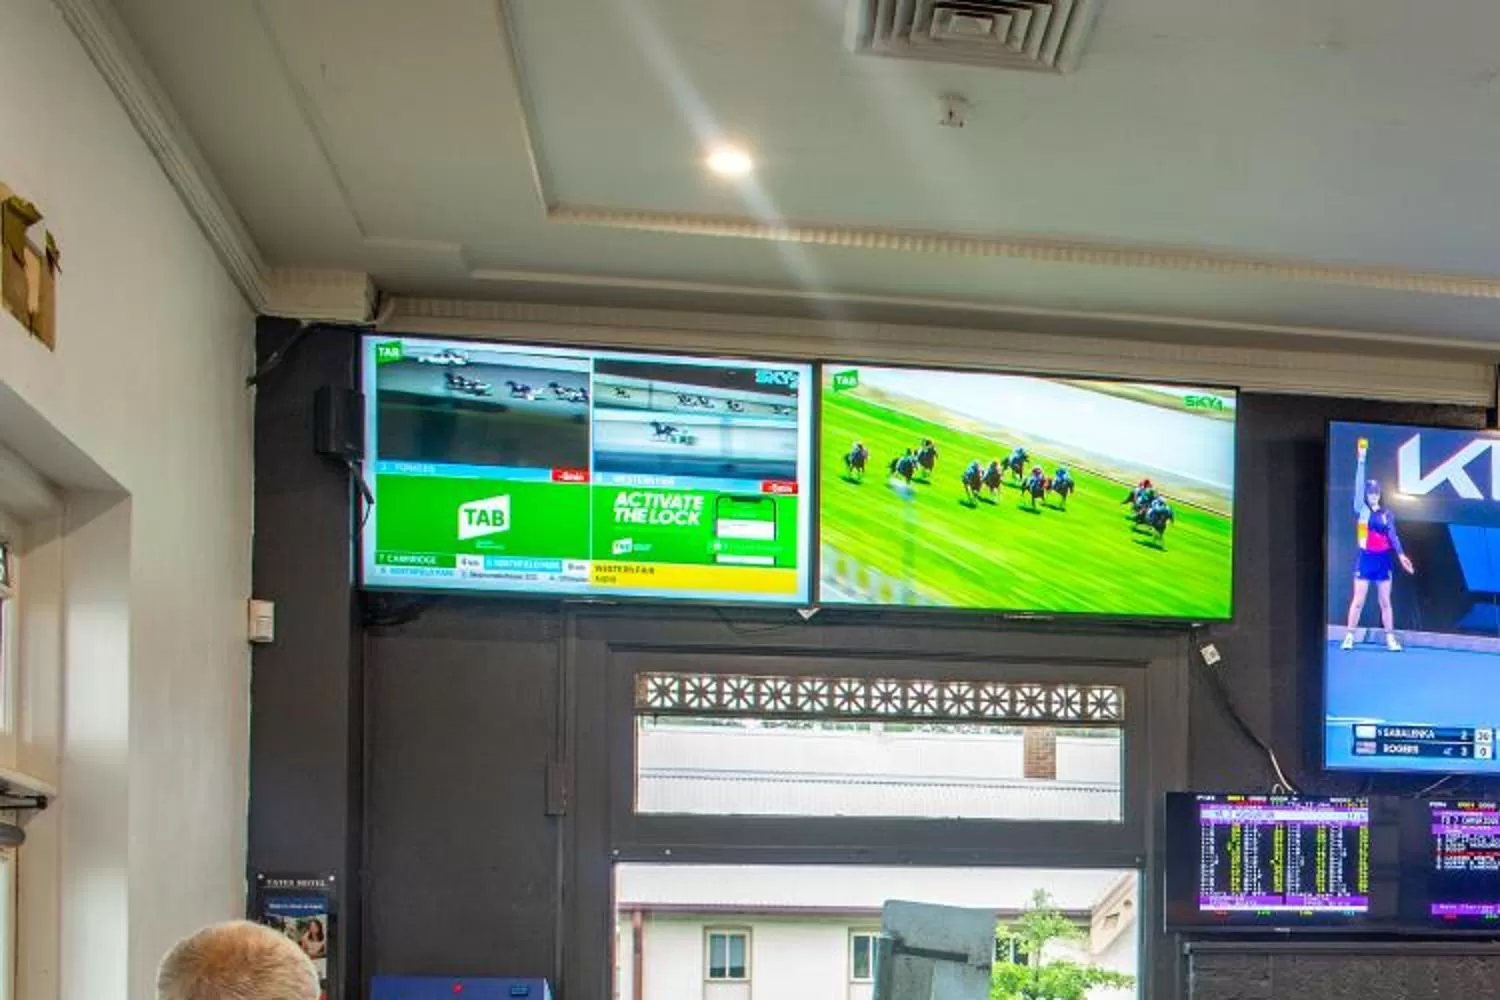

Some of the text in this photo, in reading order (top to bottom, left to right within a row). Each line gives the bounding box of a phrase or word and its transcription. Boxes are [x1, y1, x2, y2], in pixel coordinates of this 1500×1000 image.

[378, 346, 400, 358] TAB
[614, 491, 704, 511] ACTIVATE
[463, 508, 505, 528] TAB
[613, 508, 701, 526] THE LOCK
[1383, 727, 1435, 739] SABALENKA
